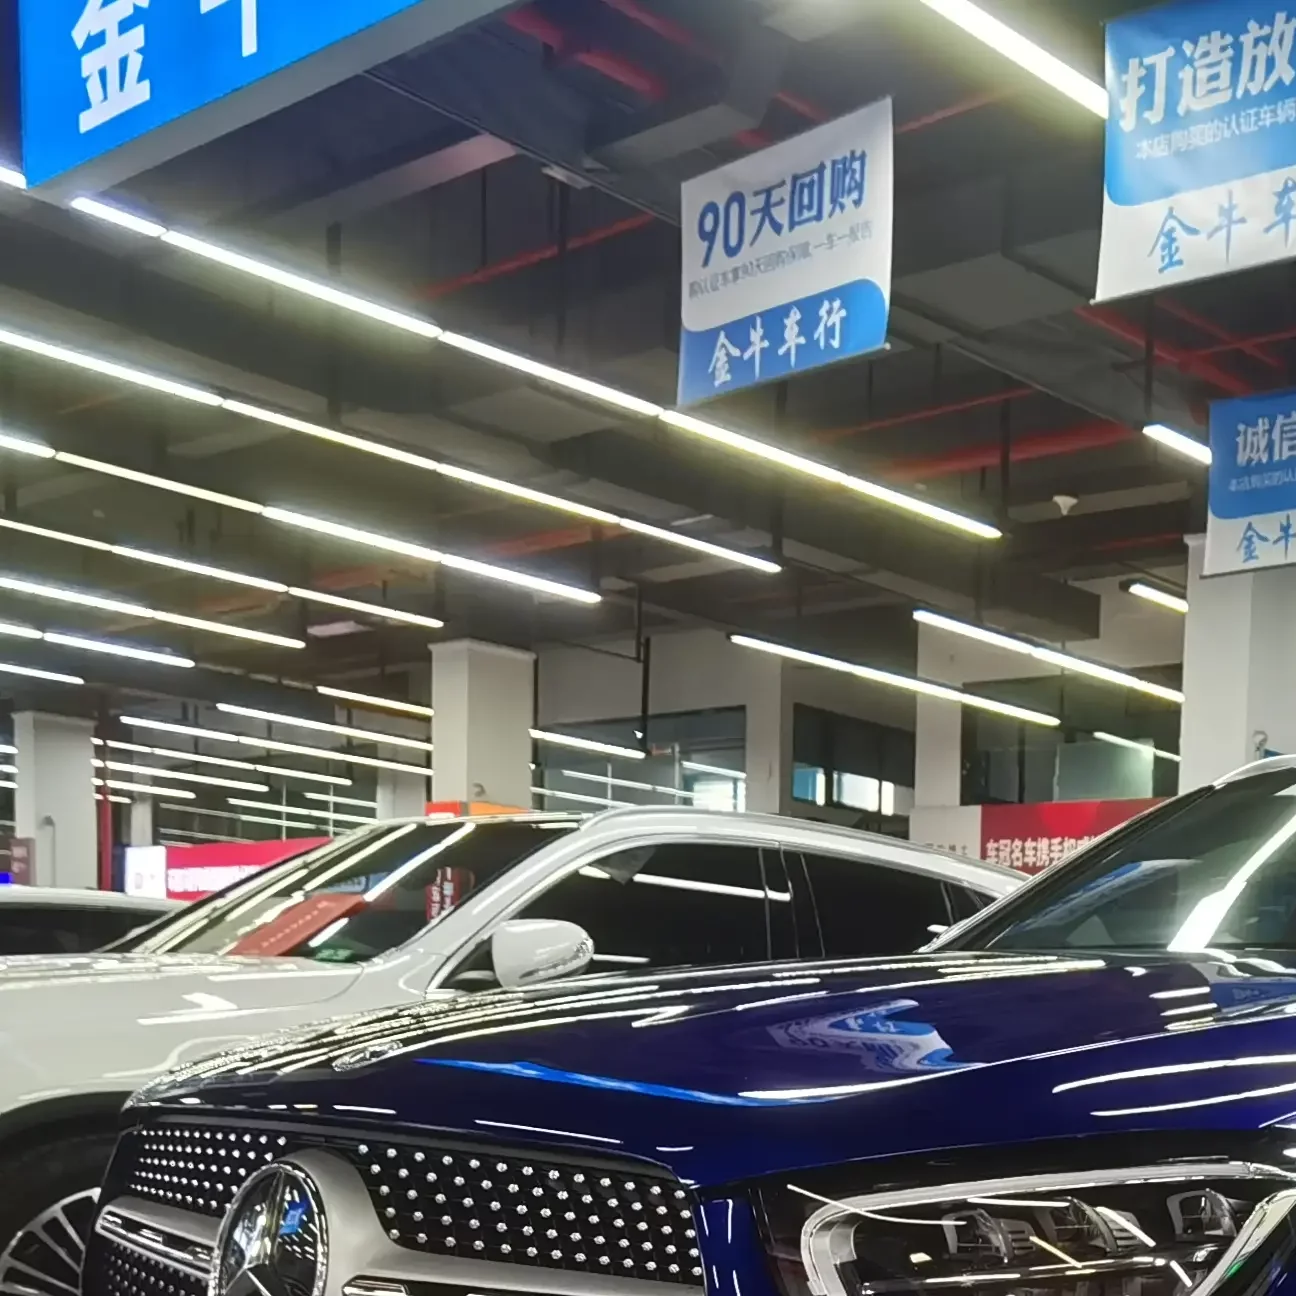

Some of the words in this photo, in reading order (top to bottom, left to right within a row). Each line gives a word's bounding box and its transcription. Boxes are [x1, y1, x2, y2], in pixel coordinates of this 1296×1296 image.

[697, 150, 868, 268] 90天回购
[707, 297, 847, 388] 金牛车行
